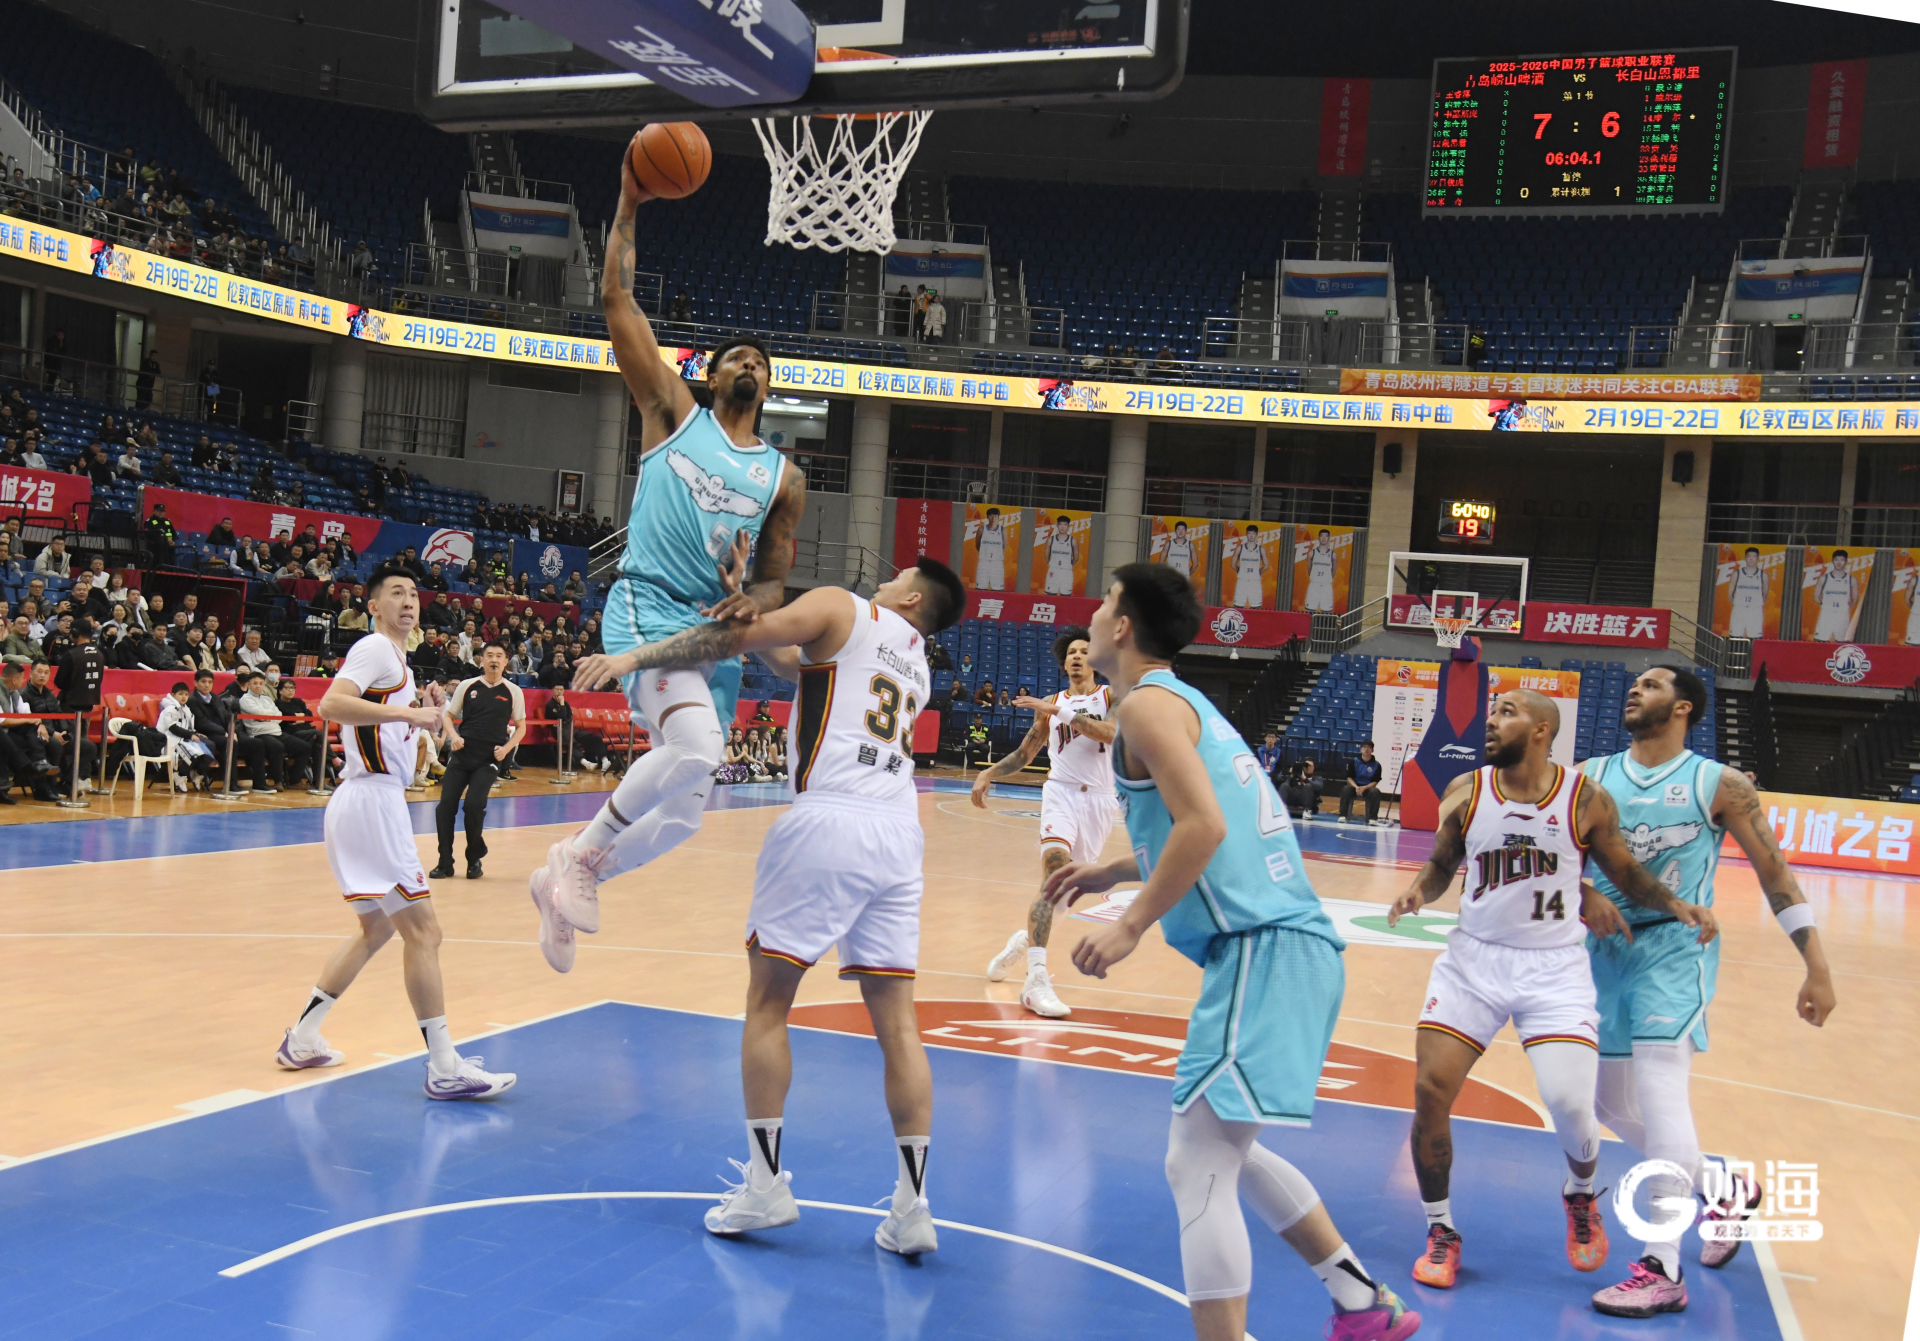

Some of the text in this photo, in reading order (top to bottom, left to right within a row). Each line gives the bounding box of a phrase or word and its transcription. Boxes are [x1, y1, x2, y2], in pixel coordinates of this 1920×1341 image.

[1573, 74, 1586, 83] VS
[1533, 113, 1552, 139] 7
[1601, 111, 1620, 138] 6
[1545, 150, 1602, 165] 06:04.1
[1520, 187, 1529, 198] 0
[1614, 186, 1621, 197] 1
[29, 230, 69, 262] 雨中曲
[146, 261, 332, 326] 2月19日-22日 伦敦西区原版 雨中曲
[403, 322, 496, 353] 2月19日-22日
[508, 335, 601, 365] 伦敦西区原版
[858, 370, 956, 397] 伦敦西区原版
[961, 379, 1010, 401] 雨中曲
[1365, 372, 1739, 396] 青岛胶州湾隧道与全国球迷共同关注CBA联赛
[1125, 390, 1454, 424] 2月19日-22日 伦敦西区原版 雨中曲
[1584, 407, 1720, 429] 2月19日-22日
[1739, 407, 1885, 430] 伦敦西区原版
[1542, 418, 1565, 432] RAIN
[694, 475, 731, 504] QINGDAO
[1458, 518, 1479, 537] 19
[976, 598, 1057, 624] 青岛
[1438, 752, 1476, 761] LI-NING
[1767, 805, 1914, 862] 以城之名
[1530, 889, 1565, 921] 14
